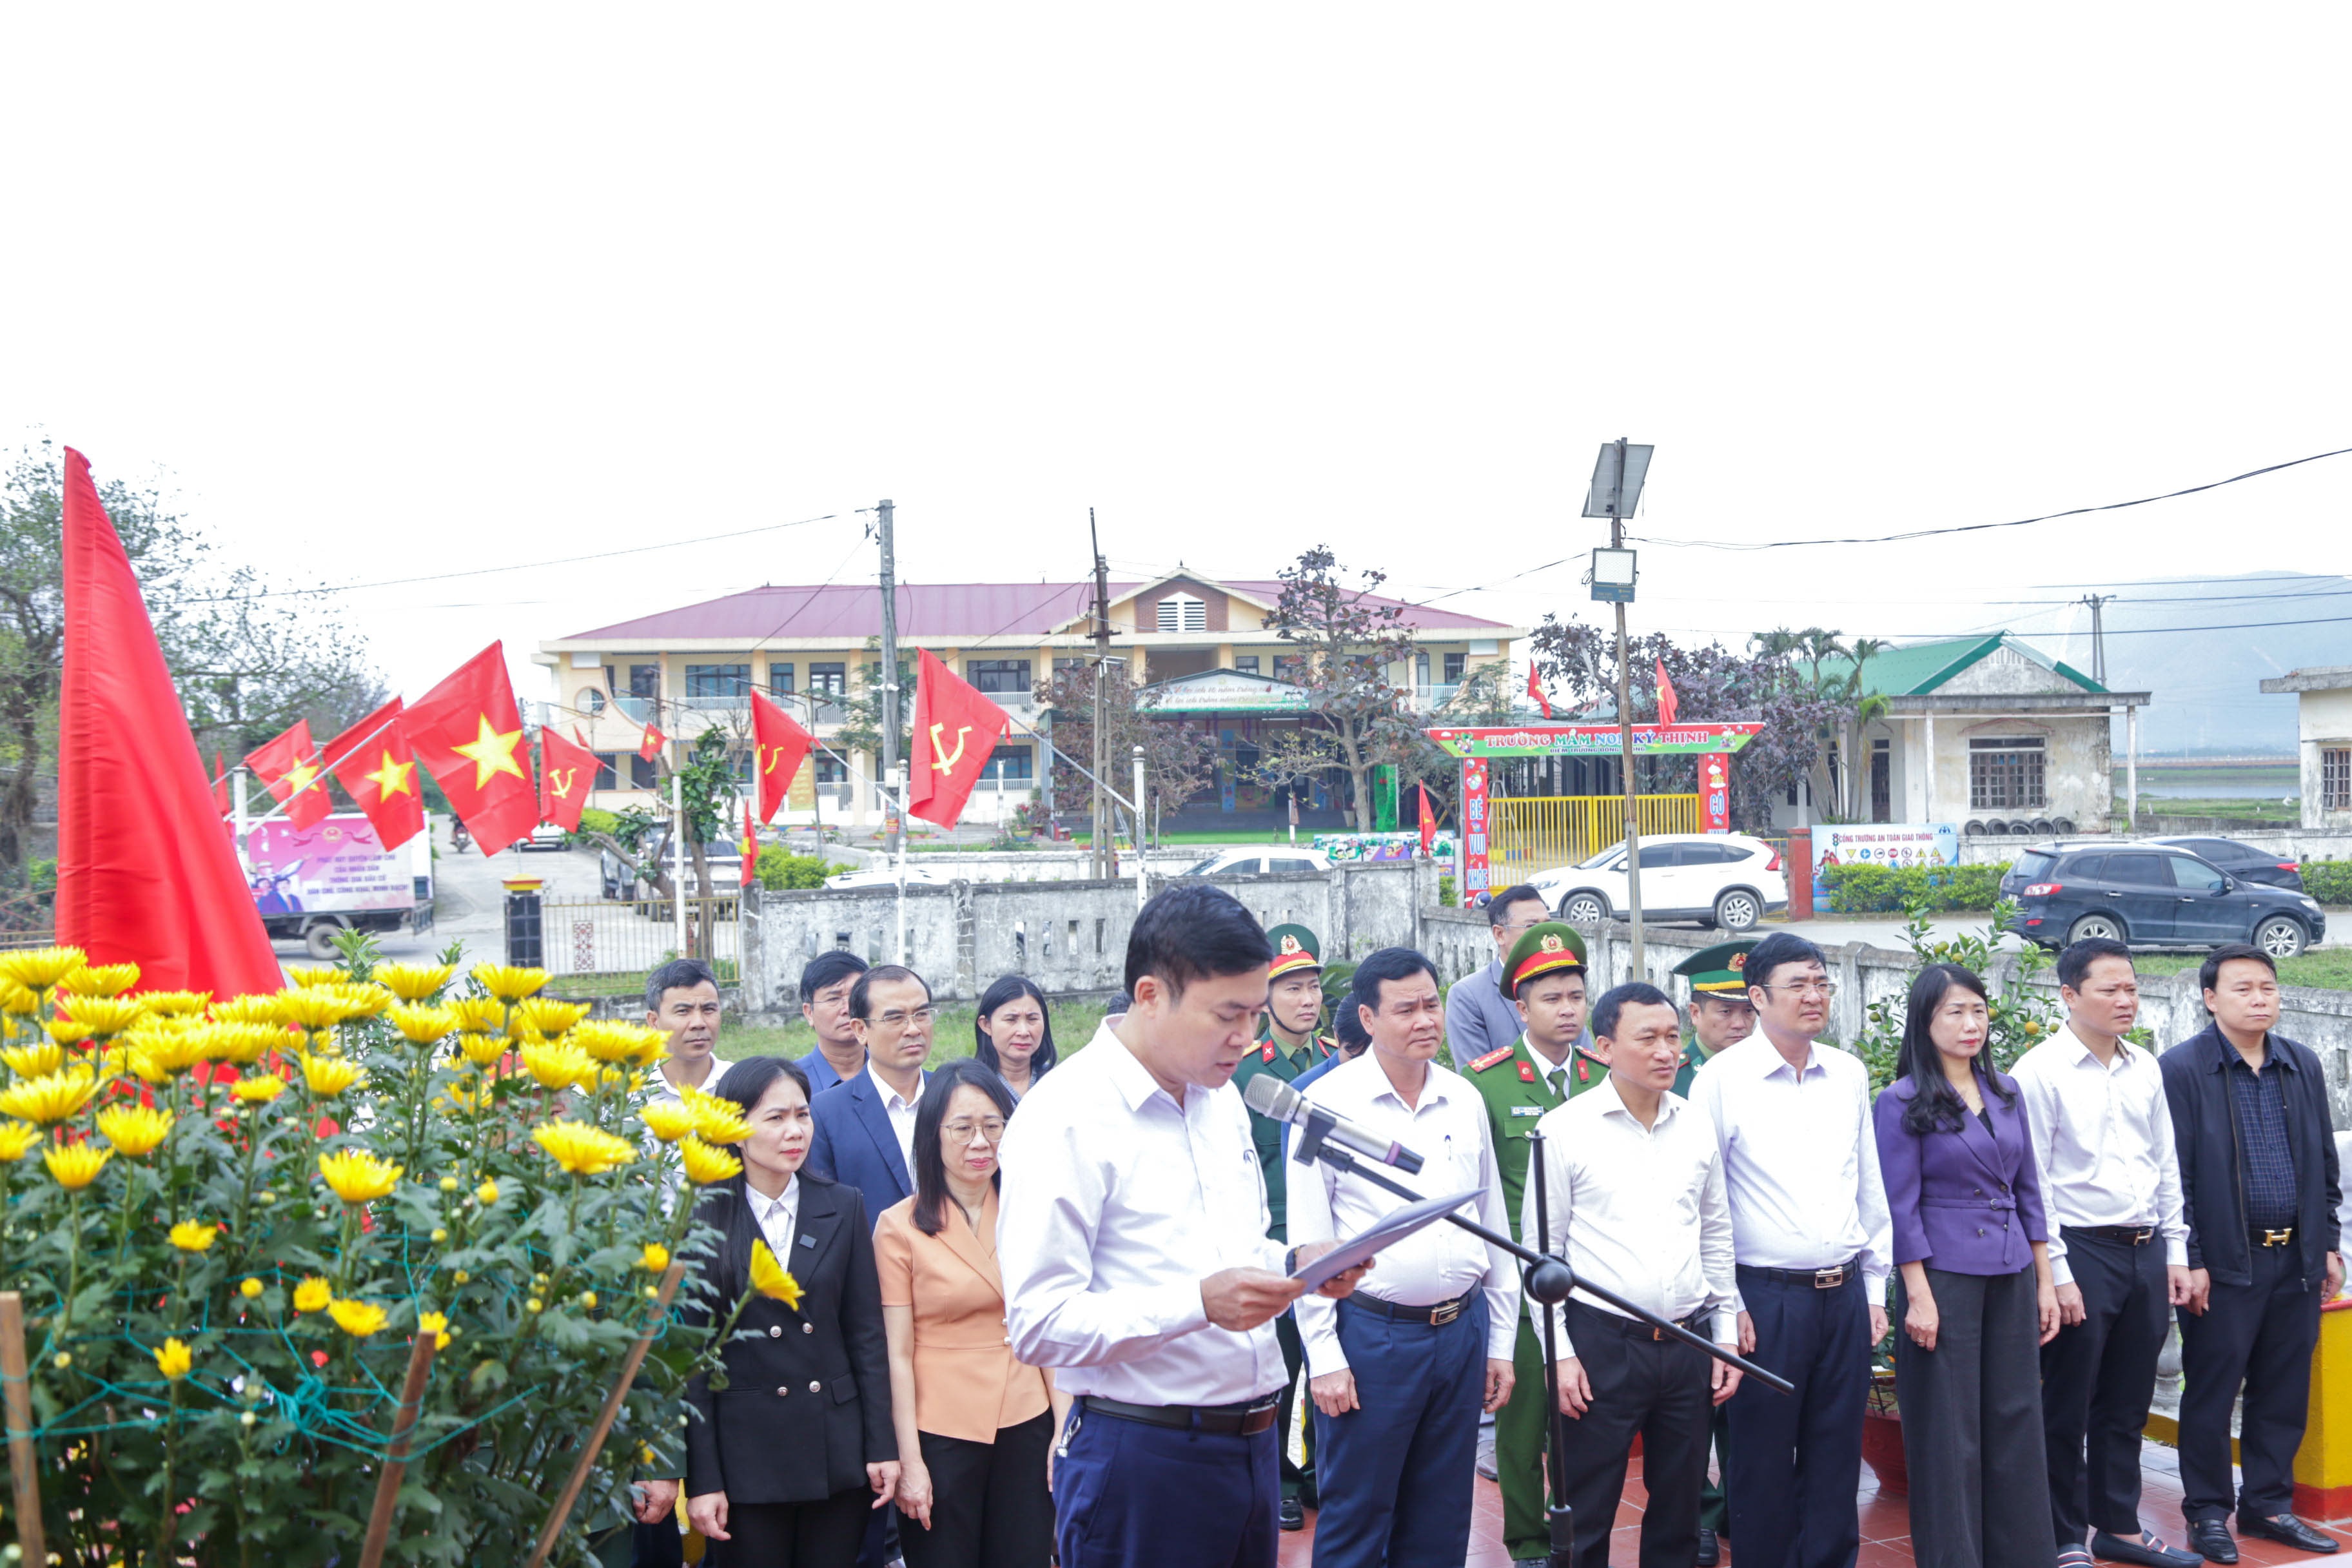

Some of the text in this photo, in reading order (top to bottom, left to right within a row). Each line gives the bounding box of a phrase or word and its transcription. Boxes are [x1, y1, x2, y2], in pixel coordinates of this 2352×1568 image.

[1485, 732, 1551, 747] TRƯỜNG
[1554, 729, 1591, 745] MẦM
[1659, 732, 1709, 747] THỊNH
[1469, 794, 1484, 820] BÉ
[1709, 790, 1725, 816] CÔ
[1468, 834, 1486, 855] VUI
[1886, 832, 1900, 841] TOÀN
[1467, 862, 1488, 890] KHỎE
